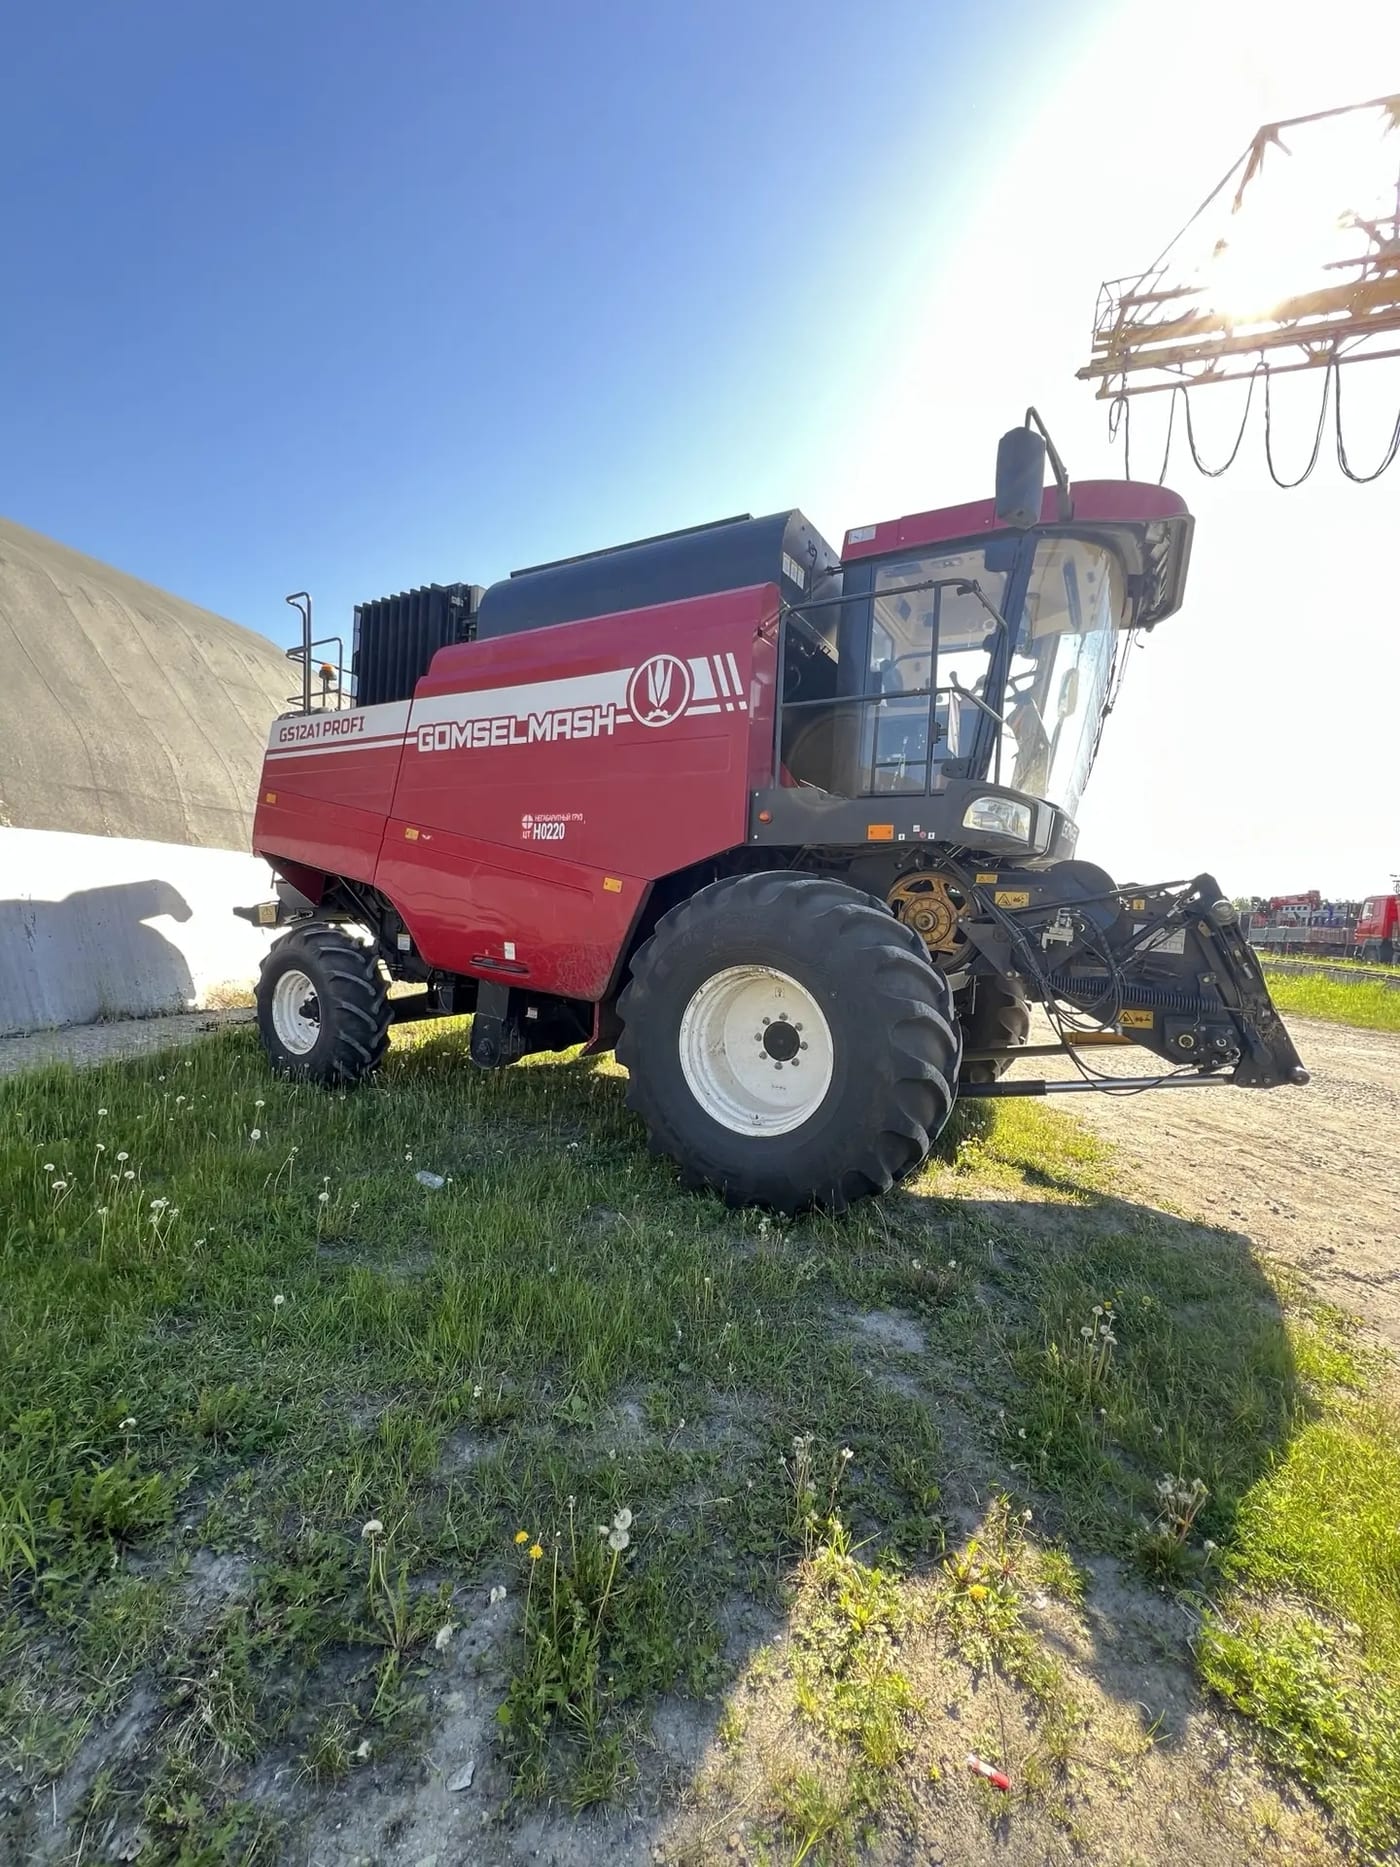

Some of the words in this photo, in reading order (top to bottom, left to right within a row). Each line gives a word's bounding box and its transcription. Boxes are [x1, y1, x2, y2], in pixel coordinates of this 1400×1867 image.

[279, 723, 320, 742] GS12A1
[322, 716, 365, 737] PROFI
[418, 705, 615, 752] GOMSELMASH
